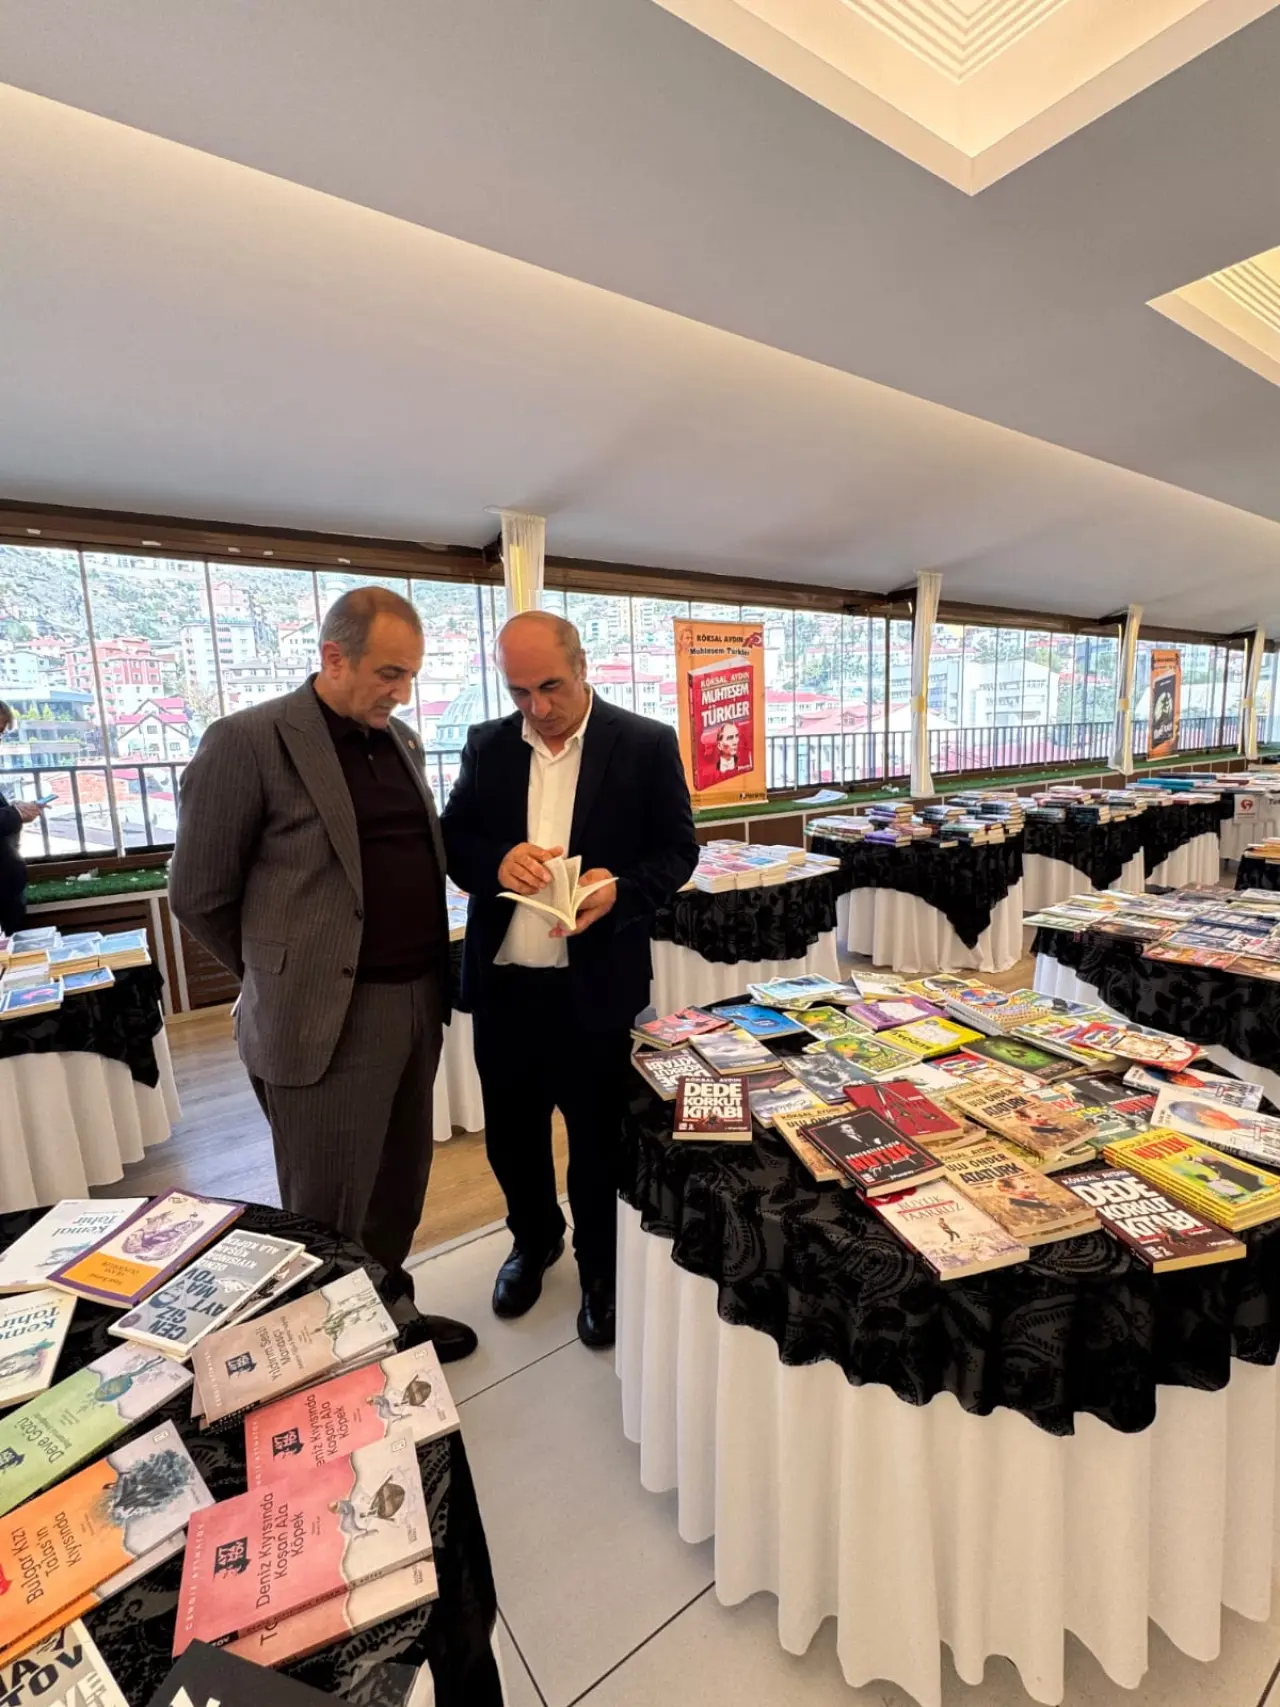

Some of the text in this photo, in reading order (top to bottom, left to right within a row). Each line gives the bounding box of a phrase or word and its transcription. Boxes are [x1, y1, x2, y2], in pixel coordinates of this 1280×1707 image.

[702, 683, 749, 706] MUHTEŞEM
[702, 701, 750, 728] TÜRKLER
[684, 1082, 742, 1097] DEDE
[684, 1097, 742, 1106] KORKUT
[982, 1096, 1031, 1116] ATATÜRK
[847, 1144, 917, 1172] NUTUK
[1124, 1136, 1193, 1160] NUTUK
[946, 1152, 1009, 1173] ULU ÖNDER
[959, 1162, 1025, 1184] ATATÜRK
[897, 1195, 944, 1210] BÜYÜK
[1071, 1177, 1160, 1207] DEDE
[73, 1214, 119, 1226] Tahir
[901, 1204, 964, 1223] TAARRUZ
[1097, 1196, 1177, 1220] KORKUT
[52, 1226, 110, 1237] Kemal
[1116, 1210, 1204, 1238] KİTABI
[256, 1243, 280, 1254] ALA
[184, 1267, 216, 1284] TOV
[186, 1282, 218, 1298] MA
[0, 1306, 60, 1328] Tahir
[188, 1301, 230, 1317] AYT
[149, 1320, 187, 1340] CEN
[13, 1416, 43, 1443] Gözü
[305, 1393, 322, 1442] Kıyısında
[320, 1401, 337, 1455] Koşan Ala
[333, 1406, 350, 1438] Köpek
[36, 1436, 64, 1464] Deve
[49, 1511, 82, 1567] Kıyısında
[275, 1504, 288, 1580] Koşan Ala
[291, 1512, 307, 1557] Köpek
[35, 1526, 60, 1577] Talas'ın
[256, 1492, 275, 1608] Deniz Kıyısında
[10, 1526, 44, 1604] Bulgar Kızı
